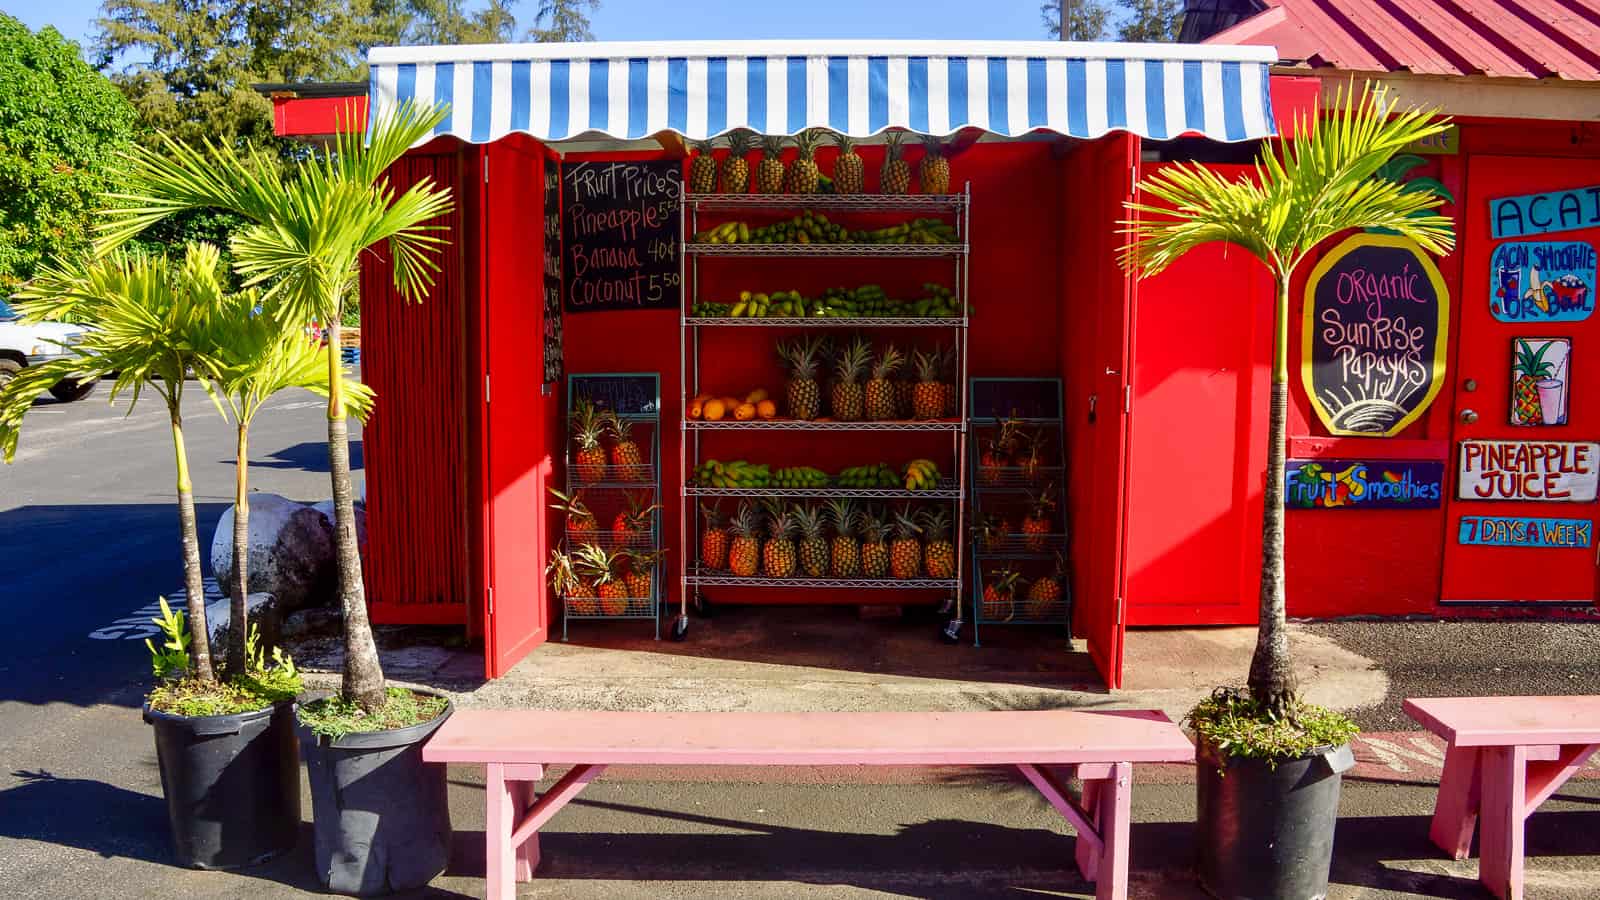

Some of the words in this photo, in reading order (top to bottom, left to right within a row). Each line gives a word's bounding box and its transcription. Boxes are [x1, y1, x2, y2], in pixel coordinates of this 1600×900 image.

[568, 200, 662, 241] Pineapple
[570, 244, 642, 277] Banana
[1533, 244, 1596, 271] SMOOTHIE
[570, 271, 647, 305] Coconut
[1508, 297, 1538, 319] OR
[1464, 443, 1589, 474] PINEAPPLE
[1285, 470, 1338, 502] Fruit
[1349, 465, 1440, 501] Smoothies
[1474, 470, 1571, 498] JUICE
[1461, 519, 1478, 541] 7
[1482, 519, 1526, 542] DAYS
[1526, 521, 1539, 543] A
[1542, 522, 1589, 545] WEEK
